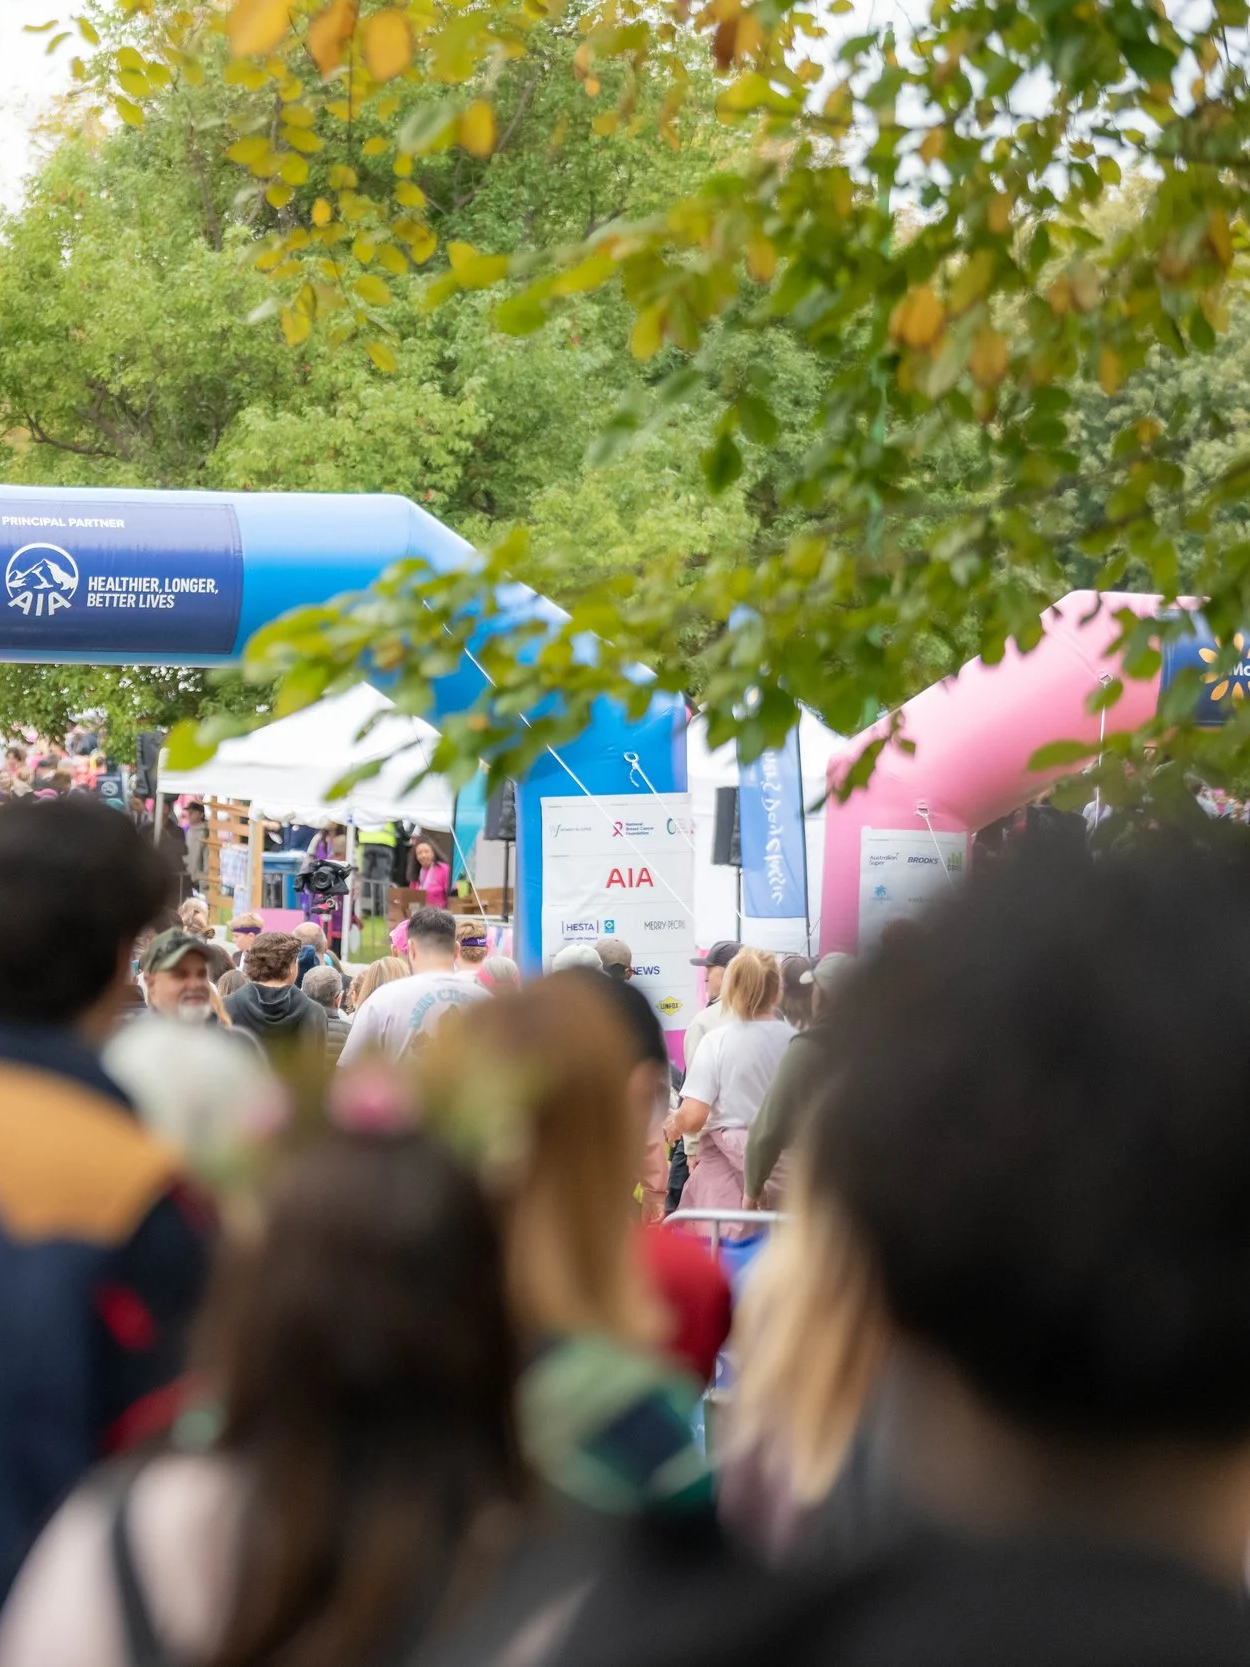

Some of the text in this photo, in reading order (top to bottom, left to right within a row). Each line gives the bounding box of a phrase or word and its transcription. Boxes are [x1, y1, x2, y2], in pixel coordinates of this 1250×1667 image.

[2, 516, 125, 528] PRINCIPAL PARTNER
[88, 576, 218, 595] HEALTHIER, LONGER,
[8, 591, 72, 617] AIA
[87, 593, 175, 609] BETTER LIVES
[907, 856, 939, 865] BROOKS
[606, 867, 654, 888] AIA
[566, 923, 595, 932] HESTA
